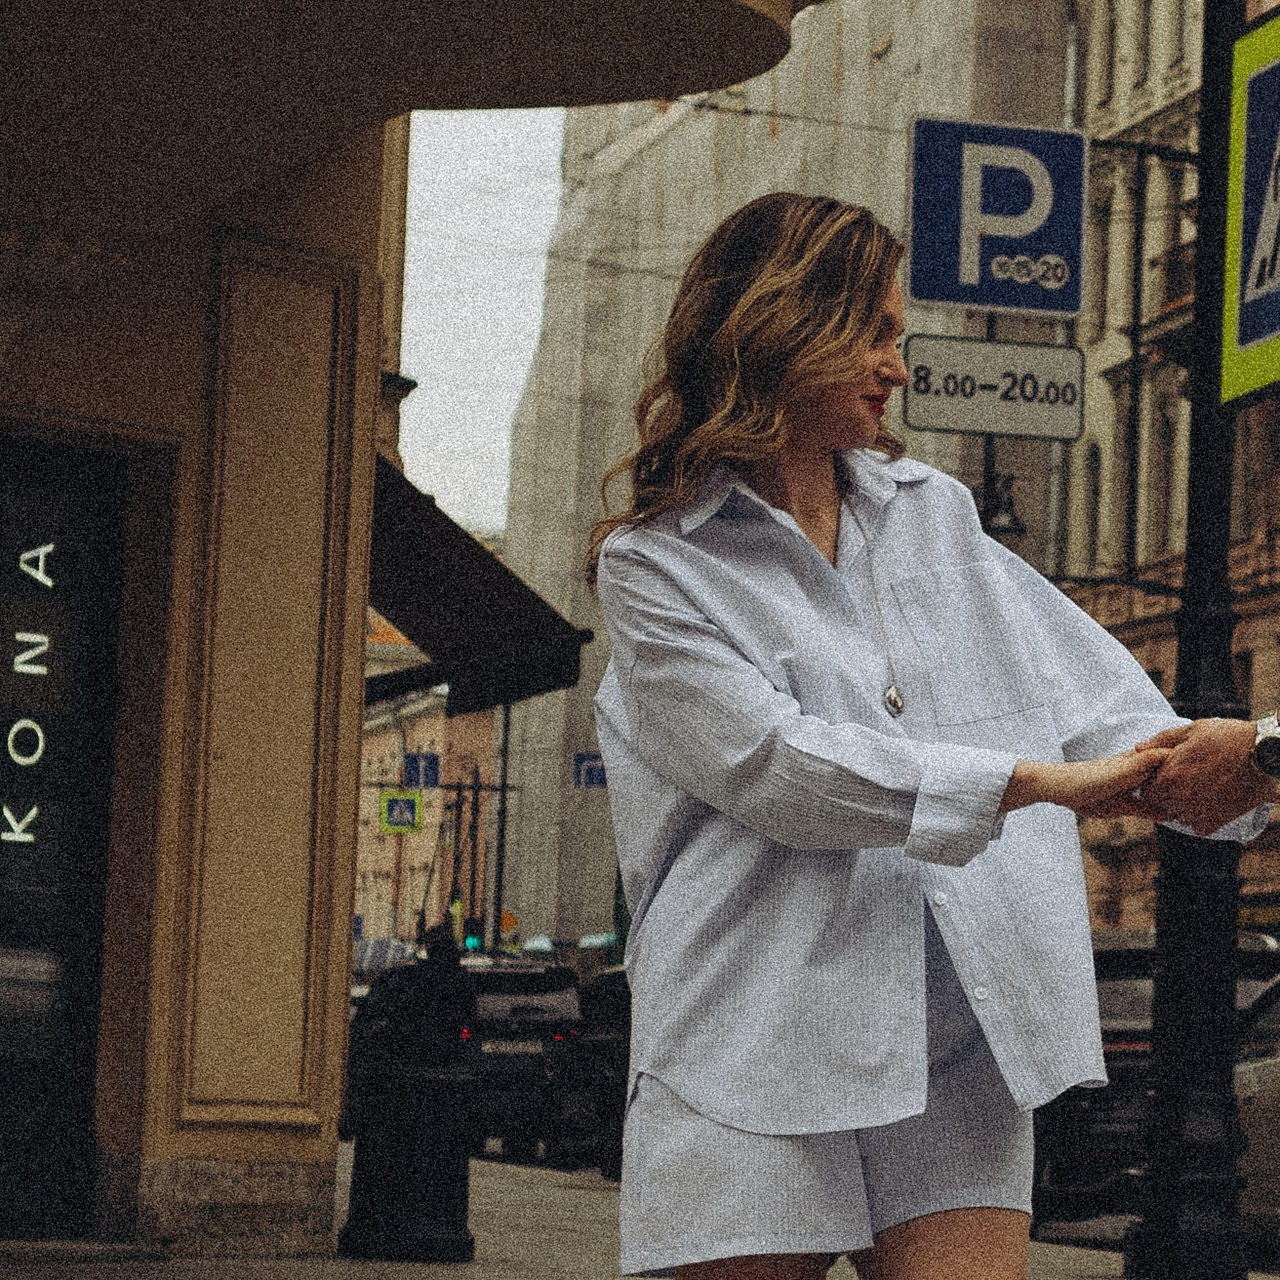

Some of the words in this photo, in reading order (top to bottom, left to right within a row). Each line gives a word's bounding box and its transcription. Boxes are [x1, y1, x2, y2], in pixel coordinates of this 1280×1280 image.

[958, 141, 1054, 286] P
[1039, 260, 1066, 283] 20
[0, 543, 56, 842] KONA
